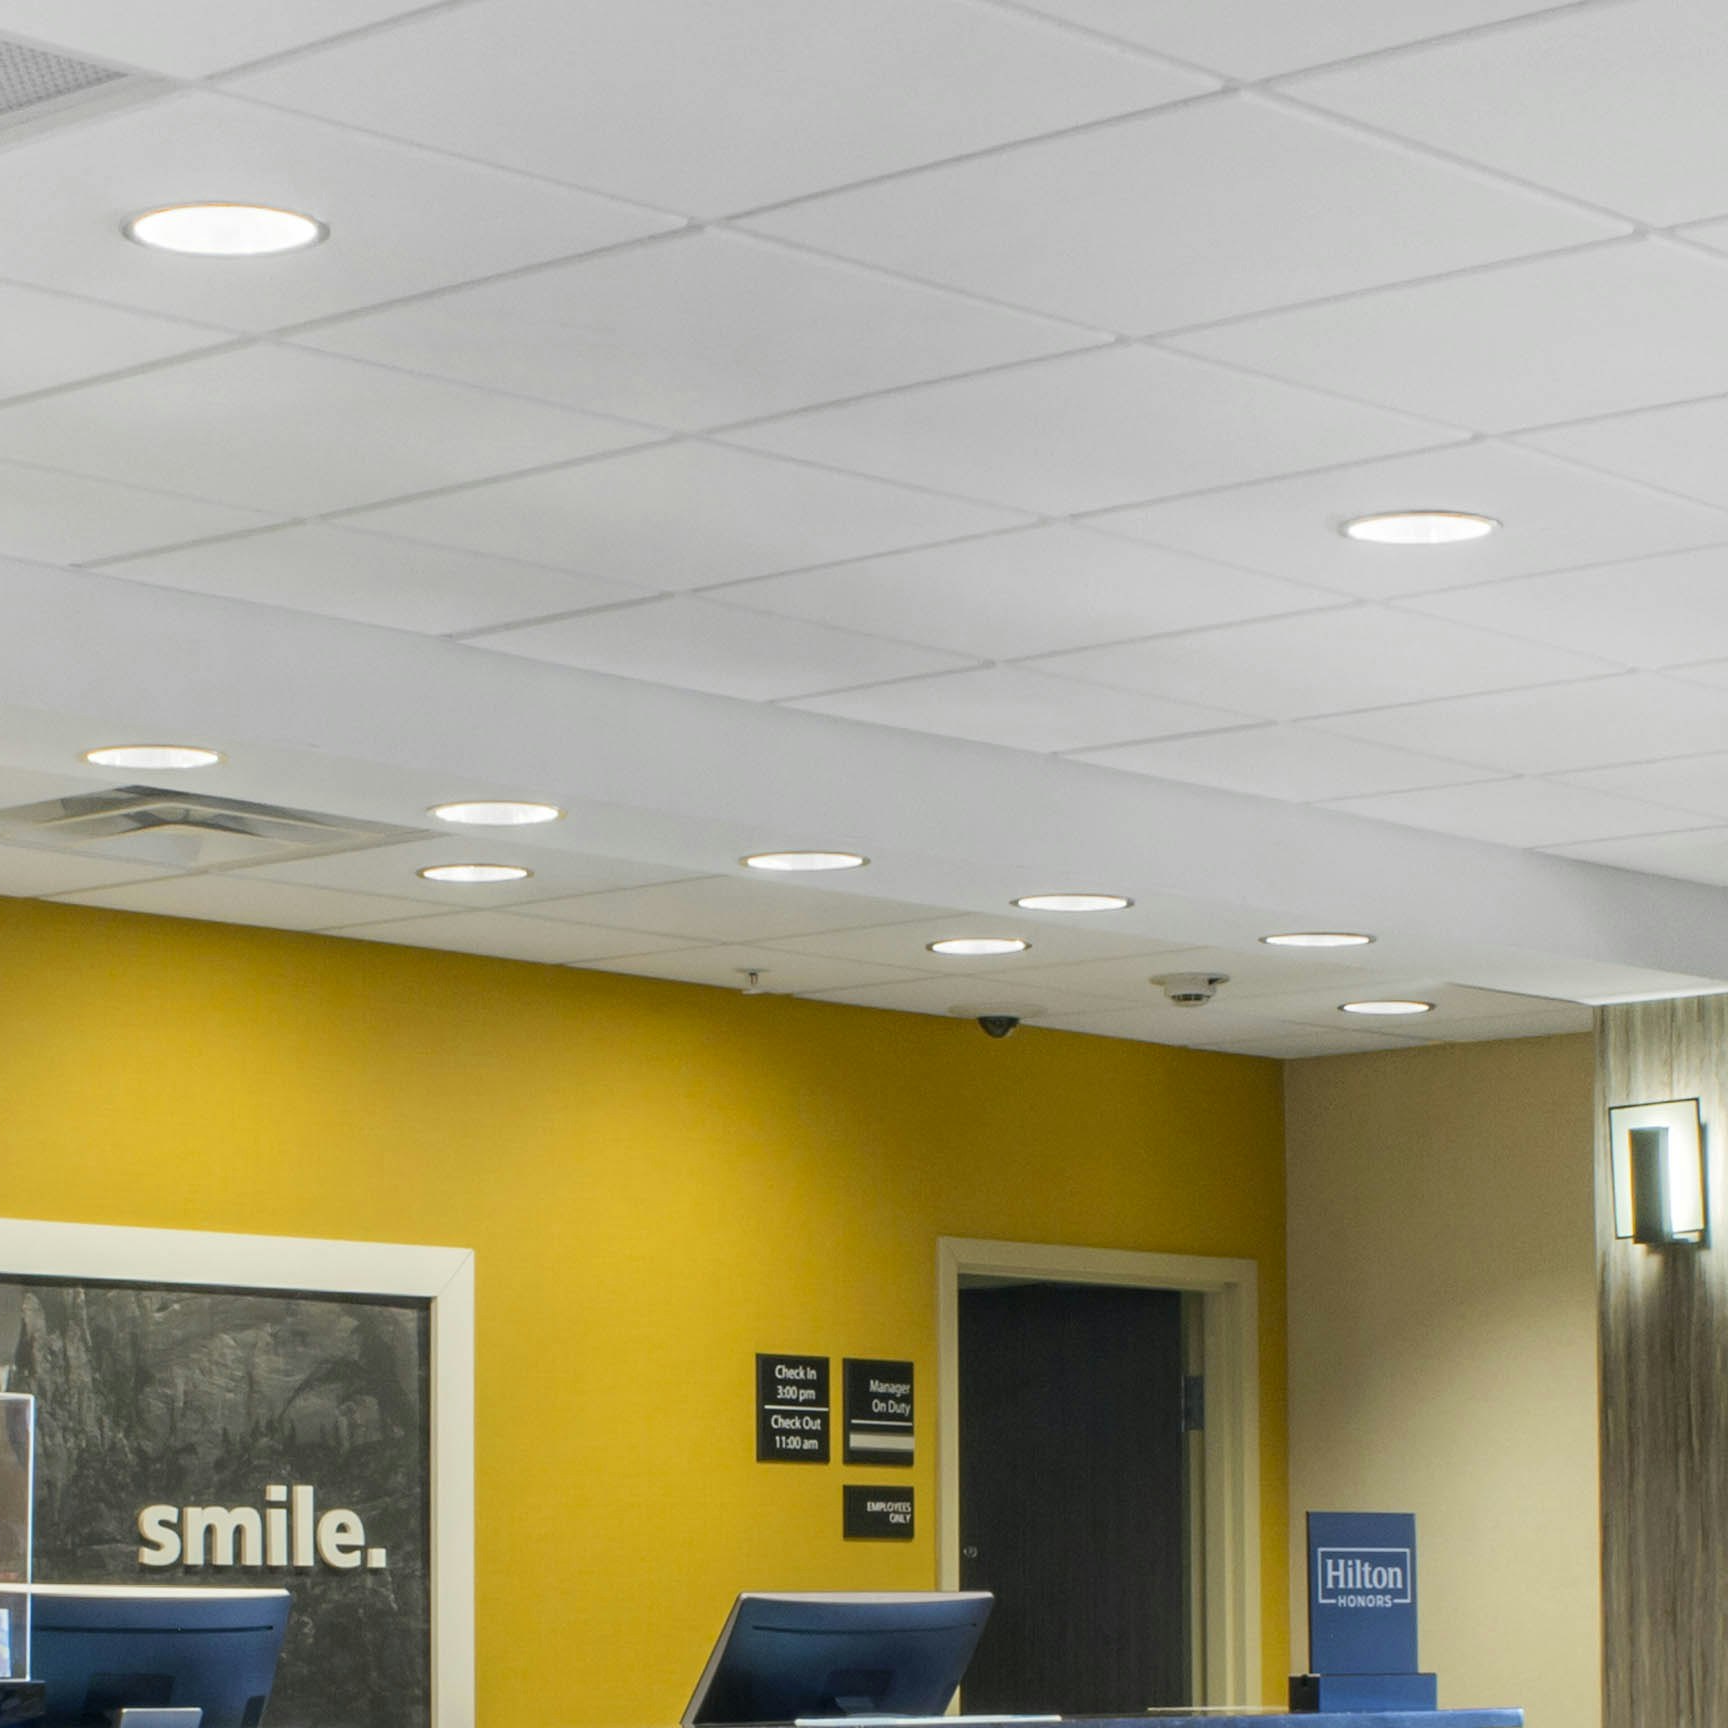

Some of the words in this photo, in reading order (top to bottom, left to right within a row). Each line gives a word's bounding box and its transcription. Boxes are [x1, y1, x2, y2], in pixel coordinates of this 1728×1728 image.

[774, 1364, 805, 1380] Check
[806, 1367, 817, 1380] In
[776, 1385, 798, 1400] 3:00
[799, 1389, 816, 1403] pm
[869, 1379, 911, 1397] Manager
[872, 1399, 887, 1413] On
[888, 1400, 911, 1417] Duty
[770, 1414, 802, 1430] Check
[802, 1416, 822, 1431] Out
[775, 1435, 802, 1450] 11:00
[802, 1439, 819, 1451] am
[866, 1501, 912, 1513] EMPLOYEES
[137, 1484, 387, 1569] smile.
[889, 1513, 912, 1524] ONLY
[1325, 1558, 1404, 1590] Hilton
[1338, 1595, 1393, 1608] HONORS
